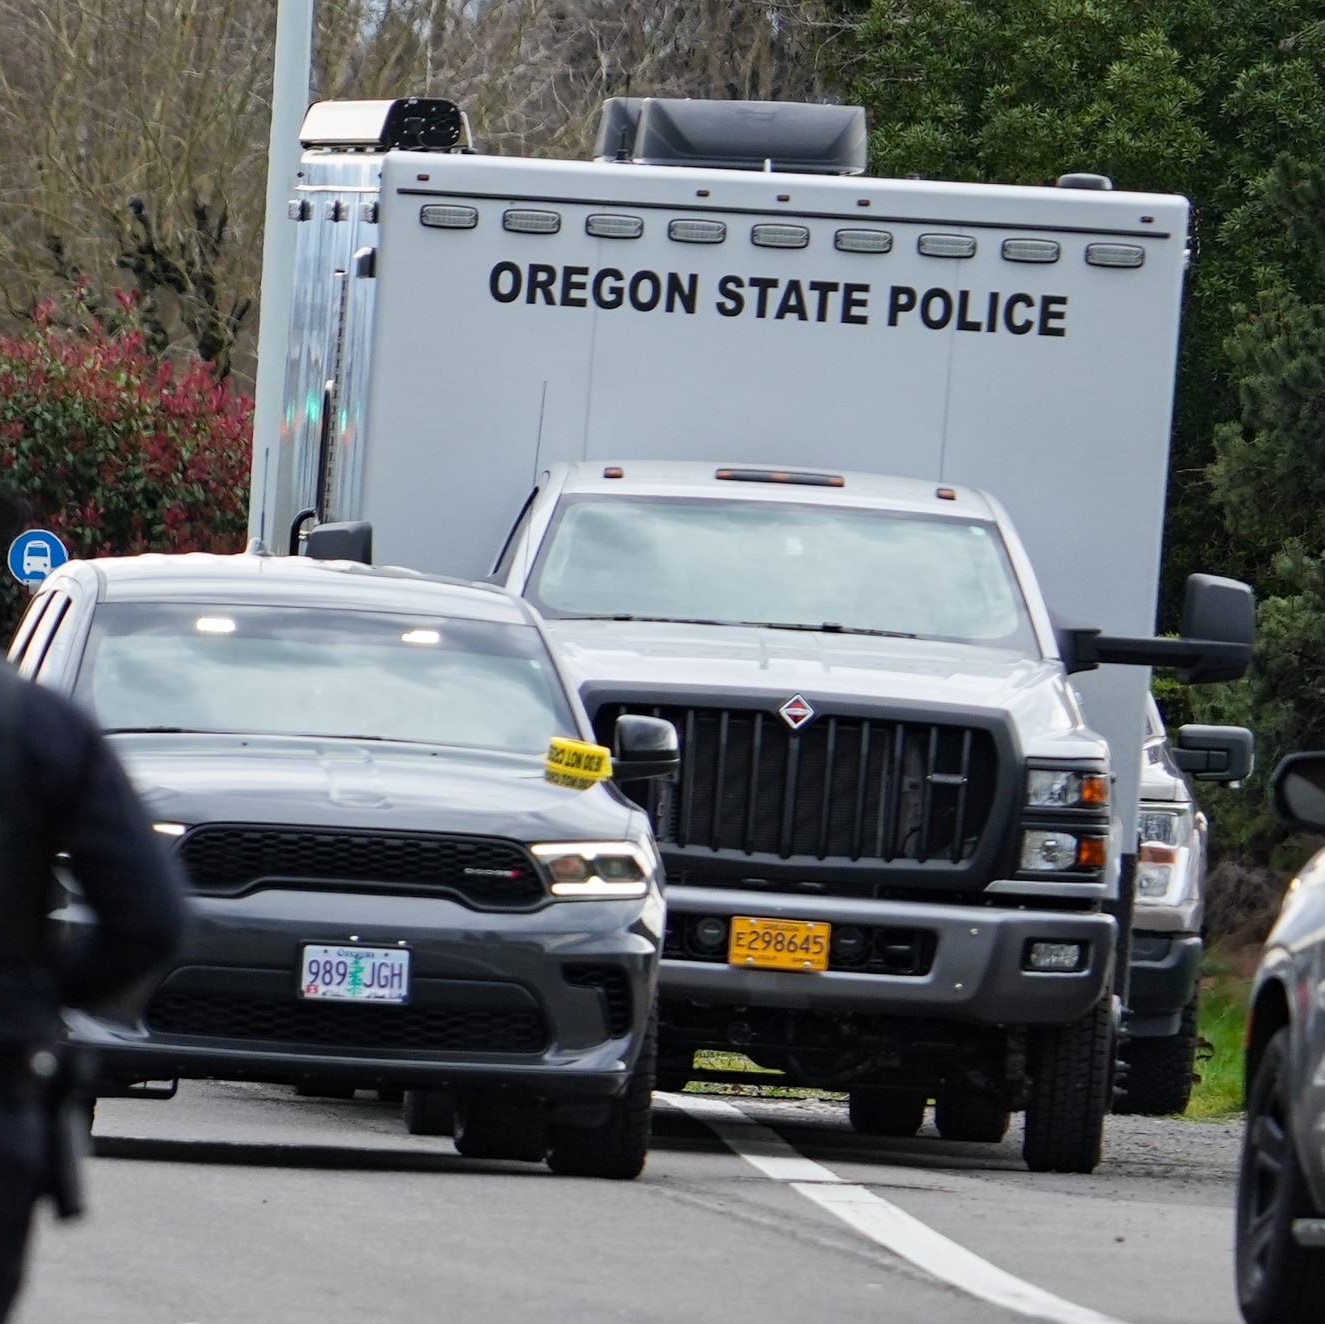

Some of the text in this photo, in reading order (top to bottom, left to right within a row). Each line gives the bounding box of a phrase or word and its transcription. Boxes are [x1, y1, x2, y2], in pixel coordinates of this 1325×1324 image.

[489, 260, 1068, 337] OREGON STATE POLICE
[337, 948, 375, 960] Oregon
[735, 930, 824, 955] E298645
[308, 959, 403, 989] 989 JGH
